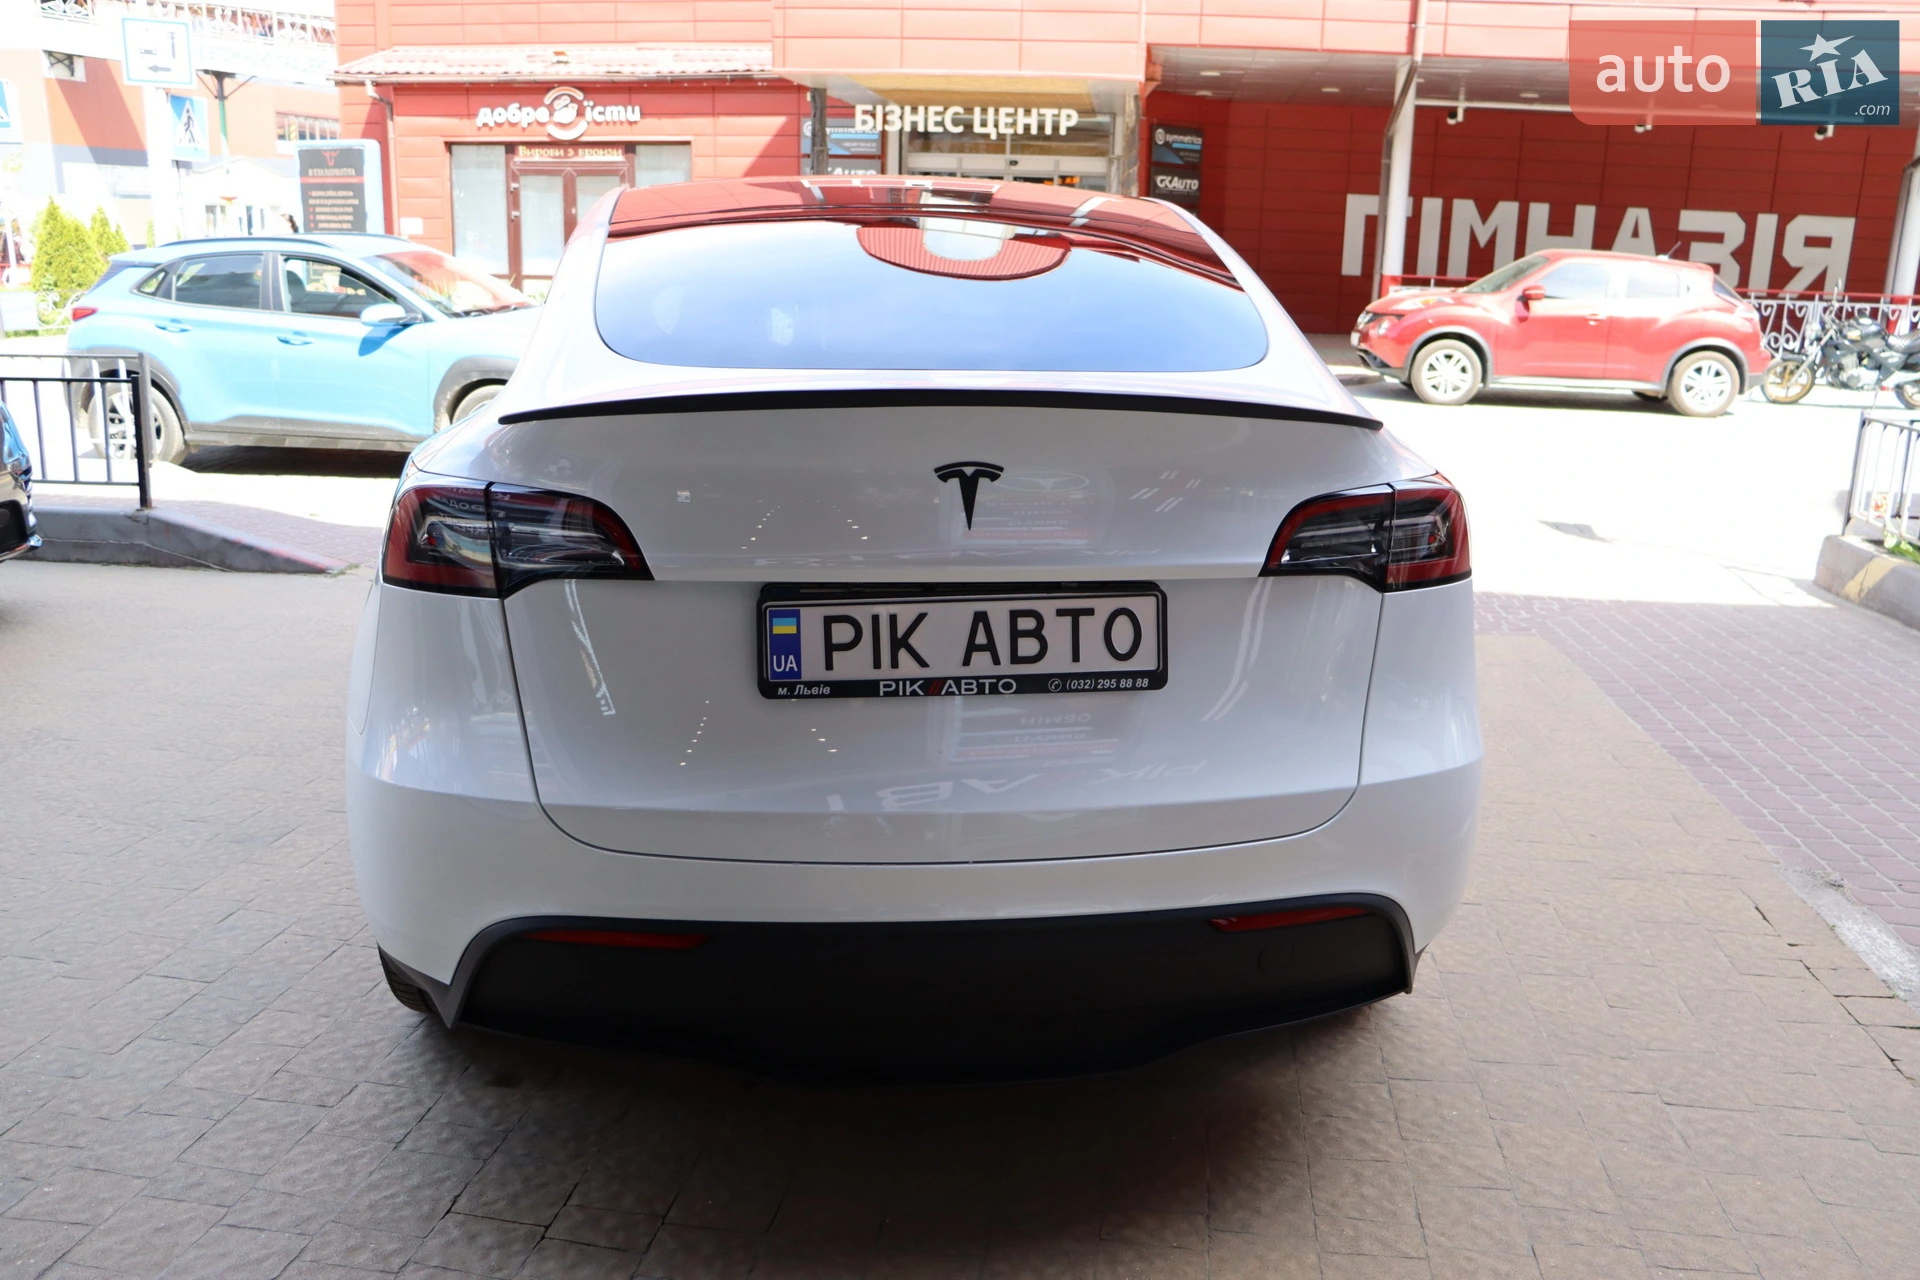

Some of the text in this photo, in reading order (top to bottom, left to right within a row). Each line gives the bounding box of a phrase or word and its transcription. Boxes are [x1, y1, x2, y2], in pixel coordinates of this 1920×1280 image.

[477, 101, 639, 127] добре їсти
[854, 104, 1079, 139] БІЗНЕС ЦЕНТР
[1344, 194, 1855, 297] ГІМНАЗІЯ
[823, 607, 1142, 671] РІК АВТО
[773, 654, 798, 673] UA
[793, 684, 831, 696] Львів
[1066, 678, 1149, 691] (032) 295 88 88
